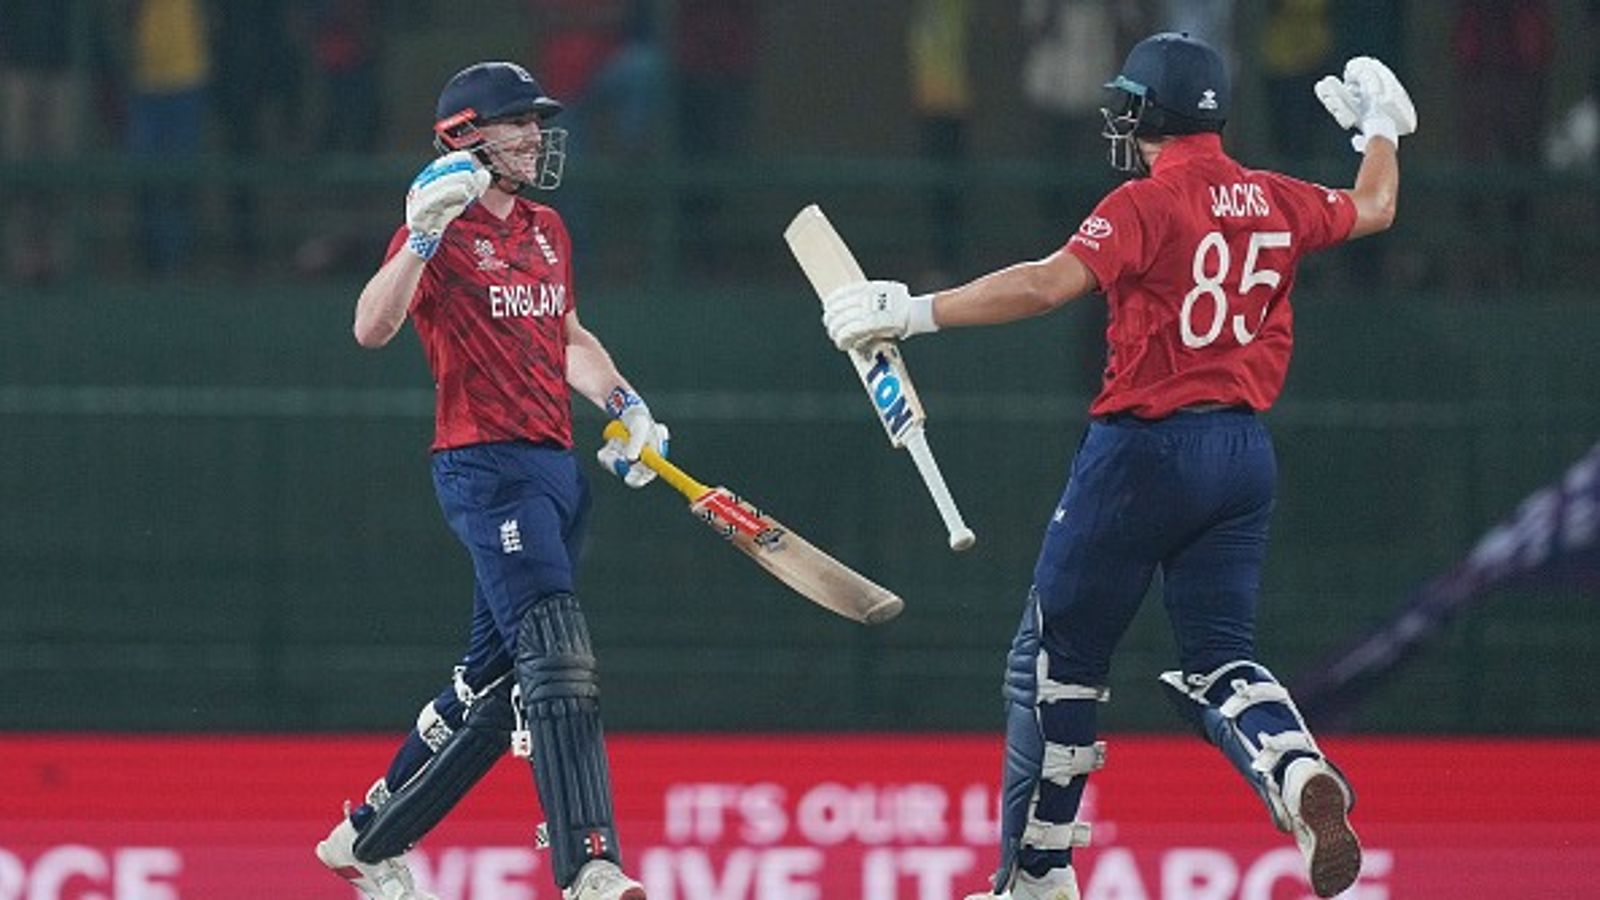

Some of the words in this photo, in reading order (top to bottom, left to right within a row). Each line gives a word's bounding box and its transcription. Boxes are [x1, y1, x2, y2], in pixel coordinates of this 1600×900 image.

[1209, 183, 1270, 217] JACKS
[1180, 231, 1291, 349] 85
[866, 351, 914, 436] TON
[796, 782, 958, 846] OUR
[642, 847, 824, 900] IVE
[862, 847, 977, 900] IT
